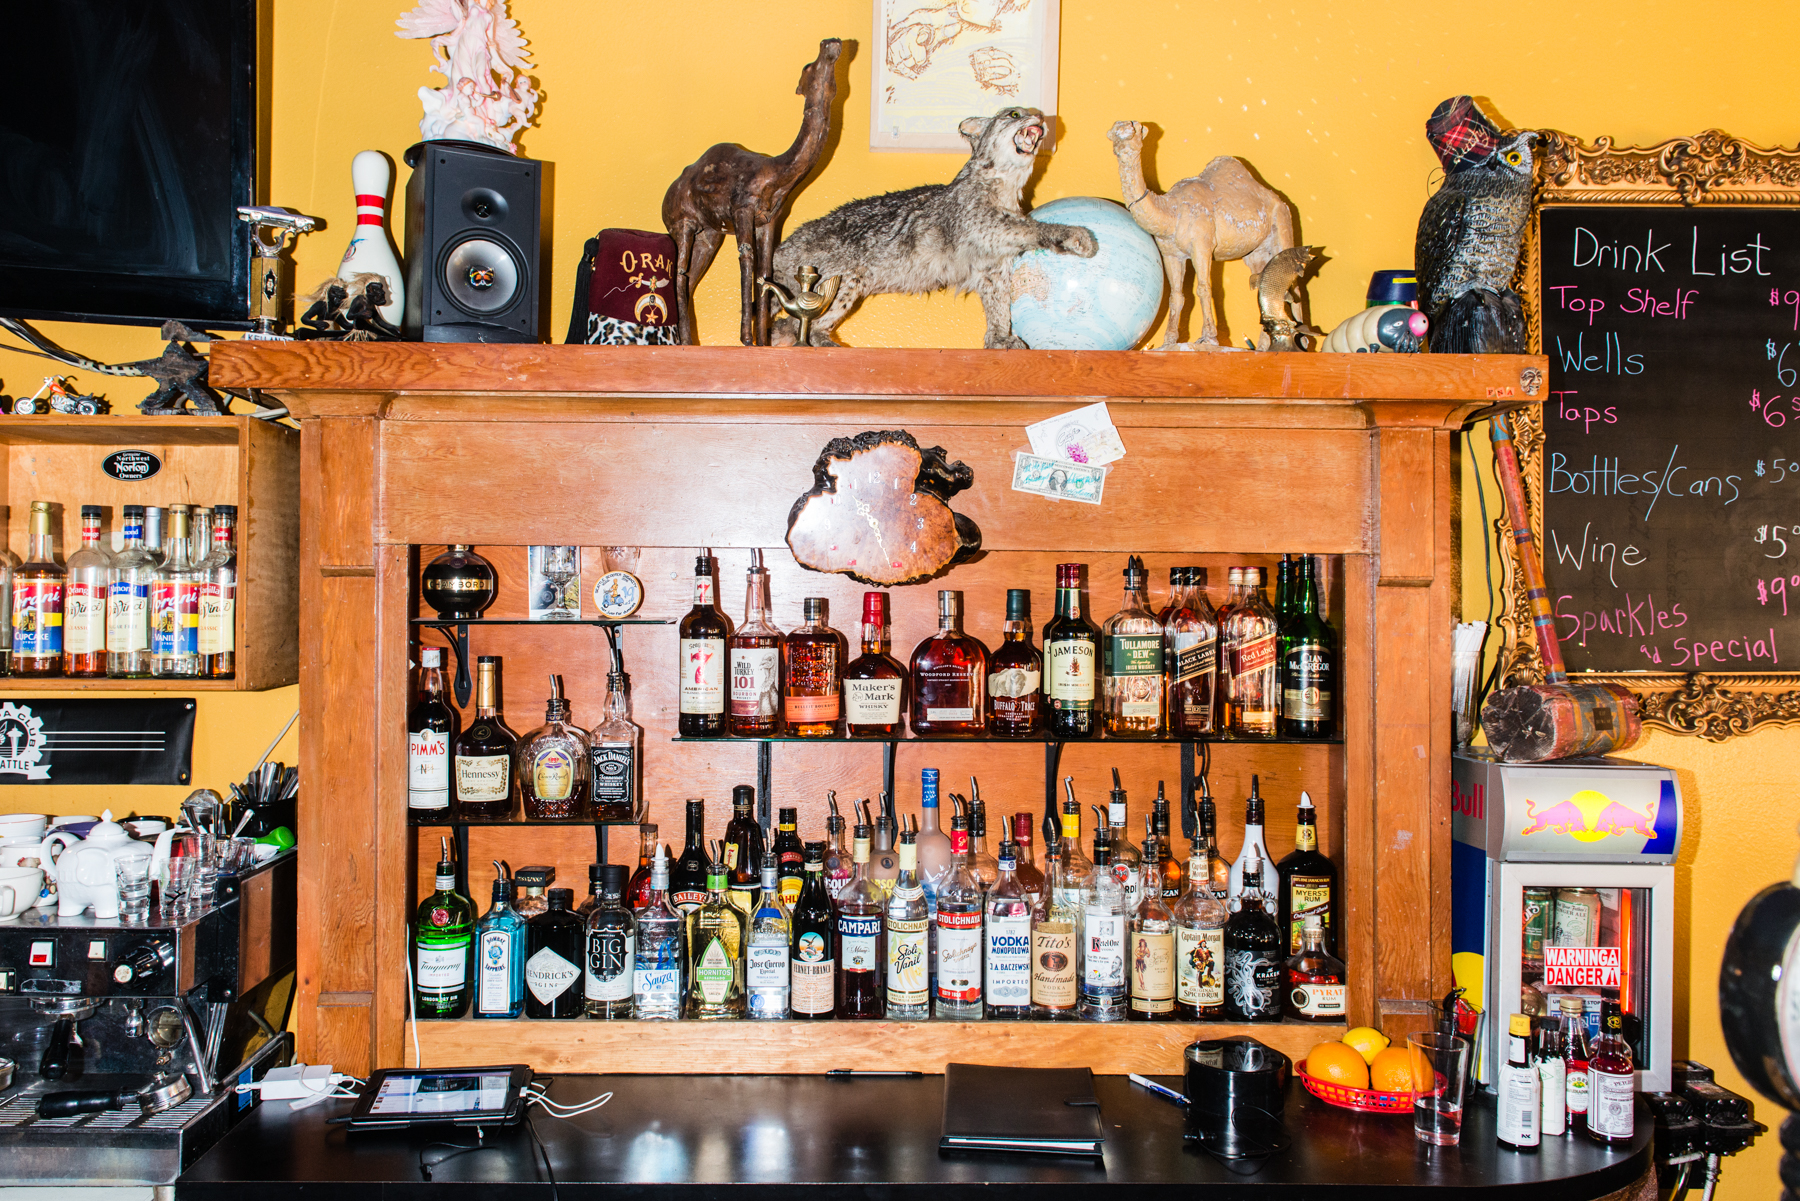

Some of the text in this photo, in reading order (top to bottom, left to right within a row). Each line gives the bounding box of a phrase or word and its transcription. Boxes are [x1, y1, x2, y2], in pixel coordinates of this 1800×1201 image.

[1574, 226, 1771, 275] Drink List
[620, 250, 673, 279] ORAN
[1550, 286, 1605, 326] Top
[1620, 288, 1699, 320] Shelf
[1557, 332, 1644, 375] Wells
[1551, 390, 1618, 434] Taps
[114, 461, 149, 474] Norton
[1550, 445, 1741, 521] Bottles/Cans
[917, 517, 925, 529] 3
[911, 541, 917, 553] 4
[1552, 522, 1647, 588] Wine
[13, 586, 60, 616] Torani
[152, 587, 198, 617] Torani
[1555, 593, 1688, 647] Sparkles
[15, 632, 49, 641] CUPCAKE
[153, 633, 185, 642] VANILLA
[1119, 638, 1160, 651] TULLAMORE
[1671, 628, 1778, 667] Special
[1053, 645, 1094, 658] JAMESON
[1177, 648, 1216, 667] BLACK LABEL
[1241, 644, 1275, 663] Red Label
[1301, 652, 1323, 663] CLAN
[690, 647, 714, 685] 7
[733, 666, 755, 676] TURKEY
[736, 661, 751, 669] WILD
[734, 676, 755, 689] 101
[852, 683, 896, 692] Maker's
[865, 693, 895, 701] Mark
[994, 699, 1036, 711] BUFFALO TRACE
[17, 712, 36, 748] CLUB
[411, 740, 446, 756] PIMM'S
[594, 751, 631, 766] JACK DANIEL'S
[461, 769, 500, 780] Hennessy
[1453, 779, 1484, 820] Bull
[1192, 862, 1207, 871] Captain
[887, 920, 928, 931] STOLICHNAYA
[938, 913, 981, 925] STOLICHNAYA
[837, 919, 881, 934] CAMPARI
[486, 936, 506, 946] BOMBAY
[991, 935, 1029, 946] VODKA
[1037, 936, 1072, 949] Tito's
[1110, 939, 1120, 947] One
[1181, 931, 1221, 942] Captain Morgan
[592, 938, 621, 954] BIG
[897, 943, 918, 961] Stoli
[942, 942, 978, 963] Stolichnaya
[991, 946, 1029, 954] MONOPOLOWA
[590, 952, 622, 969] GIN
[749, 958, 786, 970] Jose Cuervo
[894, 952, 921, 974] Vanil
[1546, 949, 1608, 966] WARNING
[421, 960, 461, 973] Tanqueray
[484, 962, 506, 972] SAPPHIRE
[1034, 972, 1075, 984] Handmade
[1256, 970, 1280, 979] KRAKEN
[1547, 967, 1603, 985] DANGER
[641, 972, 673, 991] Sauza
[1183, 990, 1205, 998] SPICED
[1312, 988, 1343, 996] PYRAT
